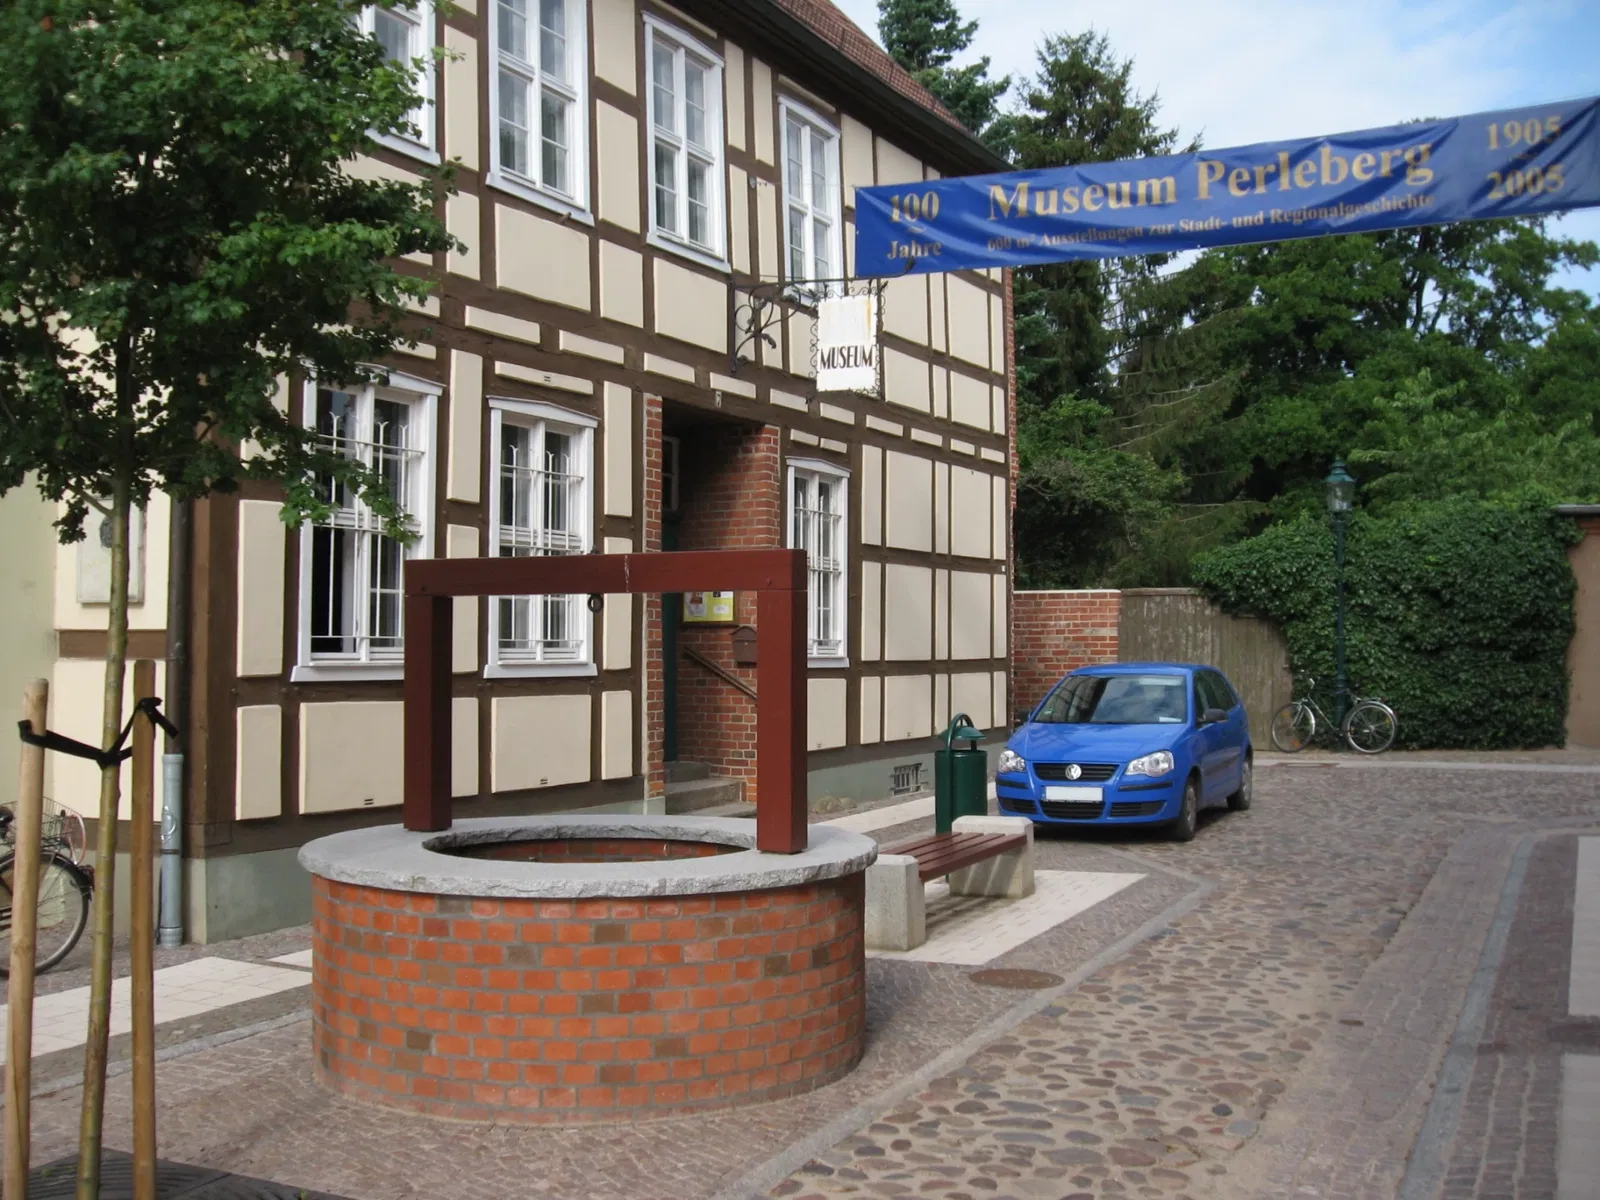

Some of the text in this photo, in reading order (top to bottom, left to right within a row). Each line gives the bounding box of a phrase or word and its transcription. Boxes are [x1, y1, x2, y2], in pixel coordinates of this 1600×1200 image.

[1488, 116, 1561, 152] 1905
[988, 143, 1435, 221] Museum Perleberg
[1487, 164, 1565, 200] 2005
[889, 191, 940, 223] 100
[1041, 225, 1144, 247] Ausstellungen
[1149, 222, 1175, 236] zur
[1179, 216, 1228, 233] Stadt-
[1232, 210, 1265, 228] und
[1270, 193, 1435, 225] Regionalgeschichte
[888, 240, 943, 260] Jahre
[819, 345, 874, 370] MUSEUM
